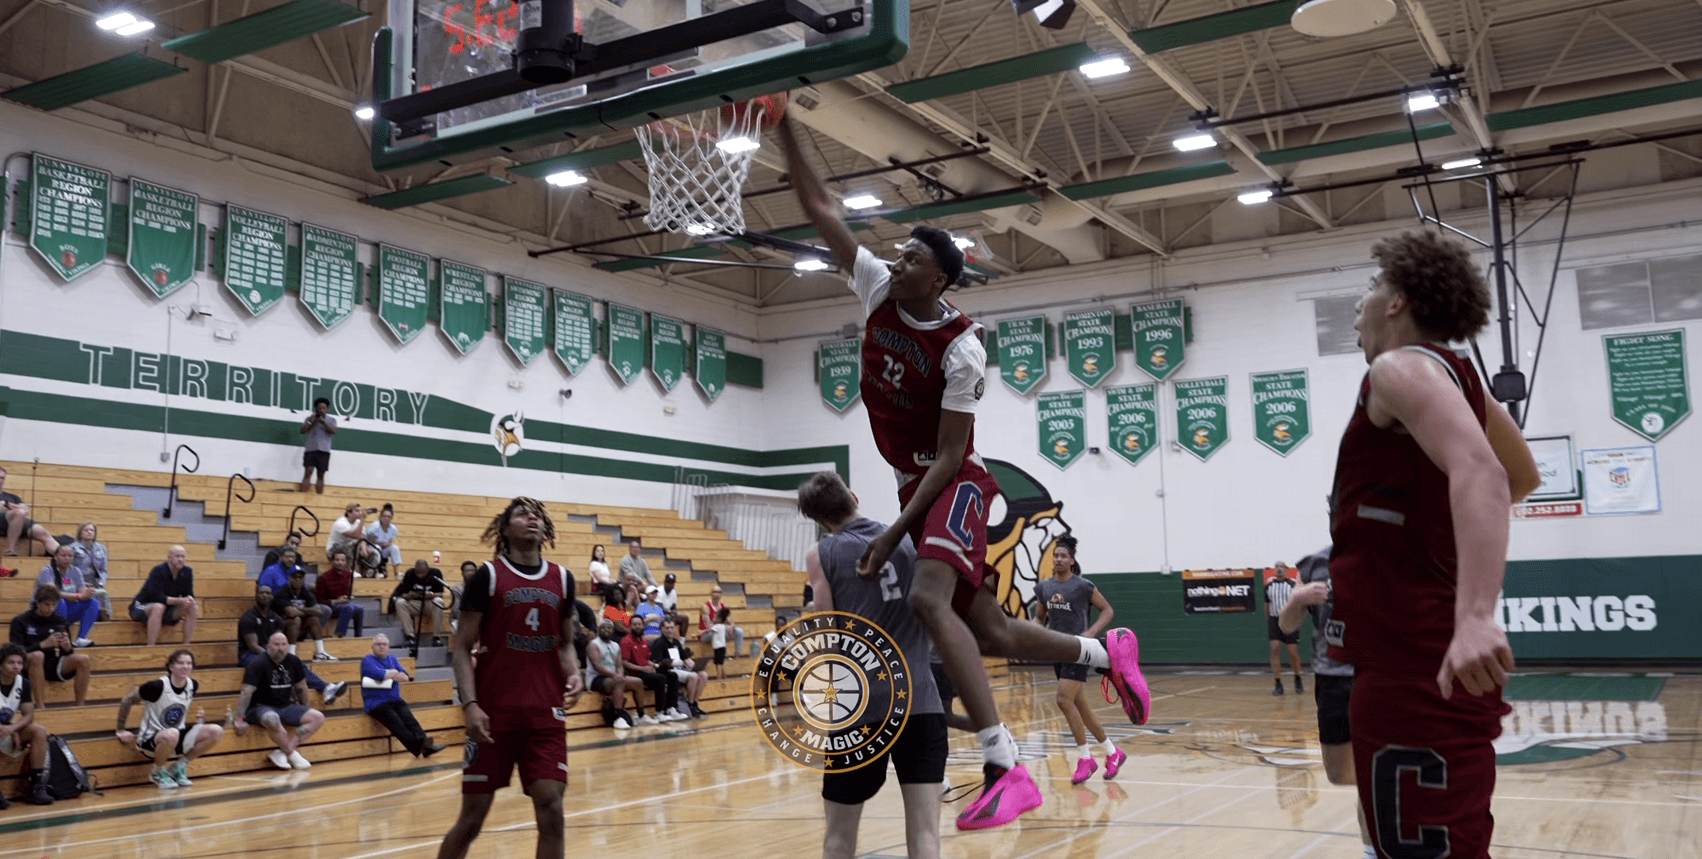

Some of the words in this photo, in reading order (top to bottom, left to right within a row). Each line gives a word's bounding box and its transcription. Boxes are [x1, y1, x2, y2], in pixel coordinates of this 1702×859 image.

[39, 166, 106, 189] BASKETBALL
[52, 179, 93, 196] REGION
[39, 187, 104, 208] CHAMPIONS
[134, 189, 193, 211] BASKETBALL
[146, 202, 182, 218] REGION
[136, 210, 192, 230] CHAMPIONS
[231, 213, 284, 234] VOLLEYBALL
[232, 232, 283, 250] CHAMPIONS
[241, 225, 275, 241] REGION
[306, 232, 353, 251] BADMINTON
[315, 243, 345, 258] REGION
[307, 250, 353, 268] CHAMPIONS
[384, 269, 426, 285] CHAMPIONS
[1136, 301, 1178, 312] BASEBALL
[1145, 310, 1170, 319] STATE
[1067, 310, 1112, 321] BADMINTON
[1078, 318, 1100, 327] STATE
[1008, 319, 1034, 329] TRACK
[1009, 327, 1032, 336] STATE
[1133, 316, 1183, 332] CHAMPIONS
[1000, 332, 1044, 348] CHAMPIONS
[1066, 325, 1113, 340] CHAMPIONS
[1145, 328, 1173, 342] 1996
[1009, 344, 1035, 358] 1976
[820, 354, 860, 368] CHAMPIONS
[882, 353, 905, 390] 22
[80, 342, 430, 427] TERRITORY
[1176, 379, 1225, 389] VOLLEYBALL
[1265, 381, 1292, 391] STATE
[1118, 393, 1143, 402] STATE
[1188, 388, 1213, 397] STATE
[1253, 388, 1307, 405] CHAMPIONS
[1048, 400, 1072, 409] STATE
[1108, 400, 1155, 416] CHAMPIONS
[1177, 395, 1227, 411] CHAMPIONS
[1265, 401, 1297, 415] 2006
[1038, 407, 1085, 422] CHAMPIONS
[1118, 412, 1147, 425] 2006
[1187, 407, 1217, 420] 2006
[945, 481, 984, 551] C
[879, 560, 902, 602] 2
[1225, 585, 1250, 597] NET
[525, 607, 540, 632] 4
[1494, 595, 1658, 632] IKINGS
[1372, 744, 1450, 859] C
